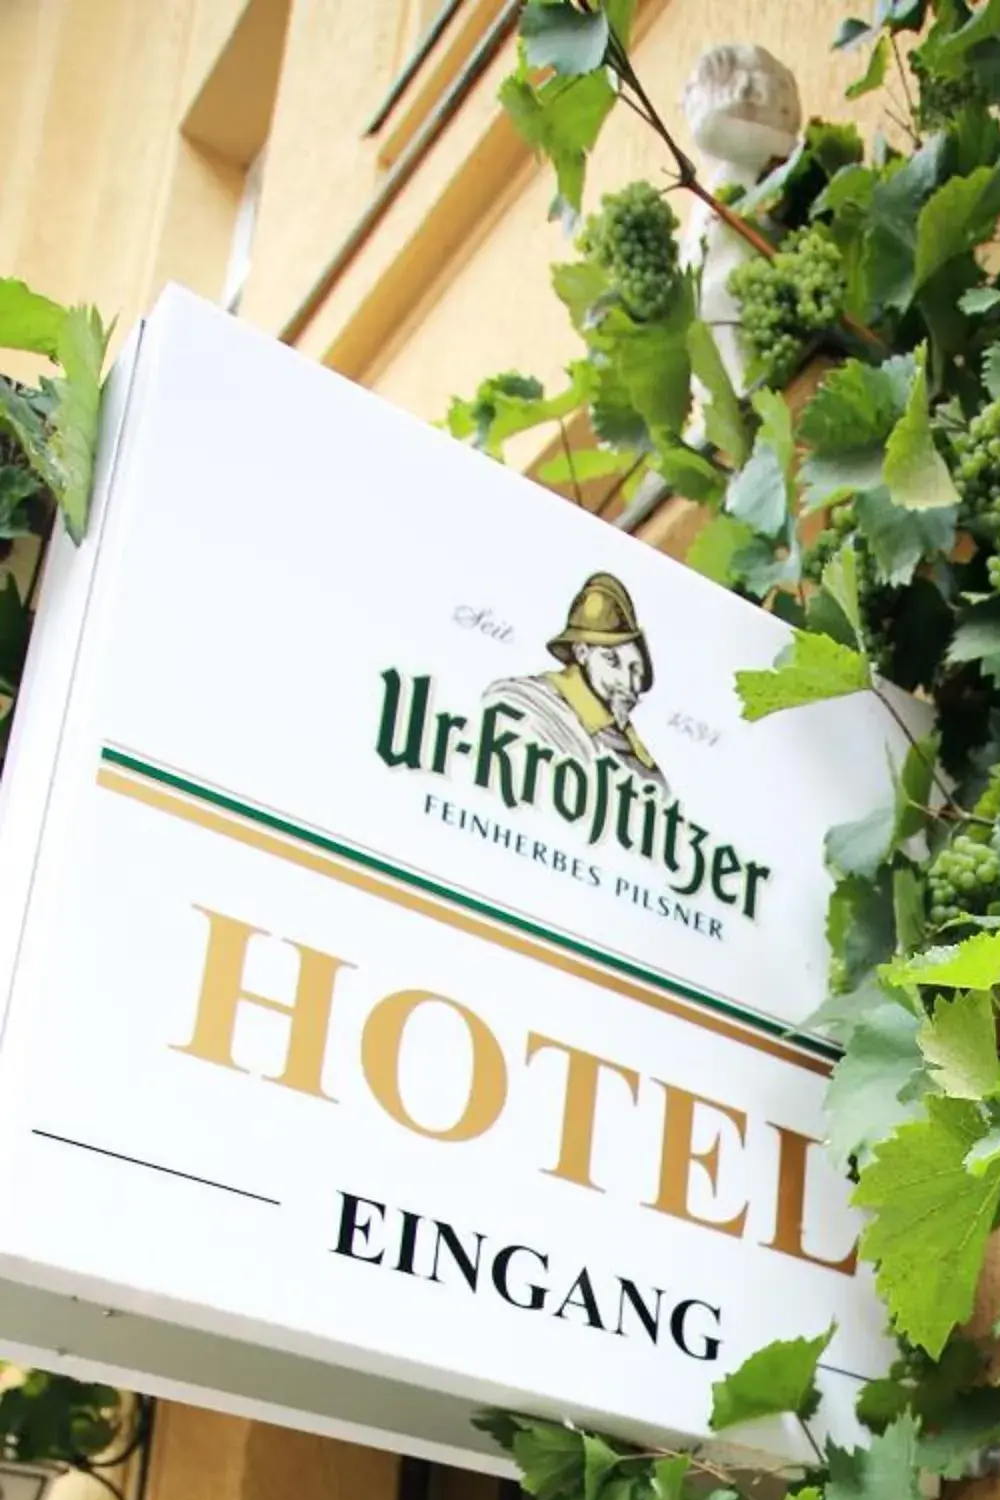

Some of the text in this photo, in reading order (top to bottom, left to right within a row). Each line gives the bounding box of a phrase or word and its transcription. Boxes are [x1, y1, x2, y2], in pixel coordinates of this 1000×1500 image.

[452, 604, 515, 645] Seit
[423, 793, 725, 942] FEINHERBES PILSNER
[169, 903, 860, 1277] HOTEL
[329, 1190, 723, 1362] EINGANG
